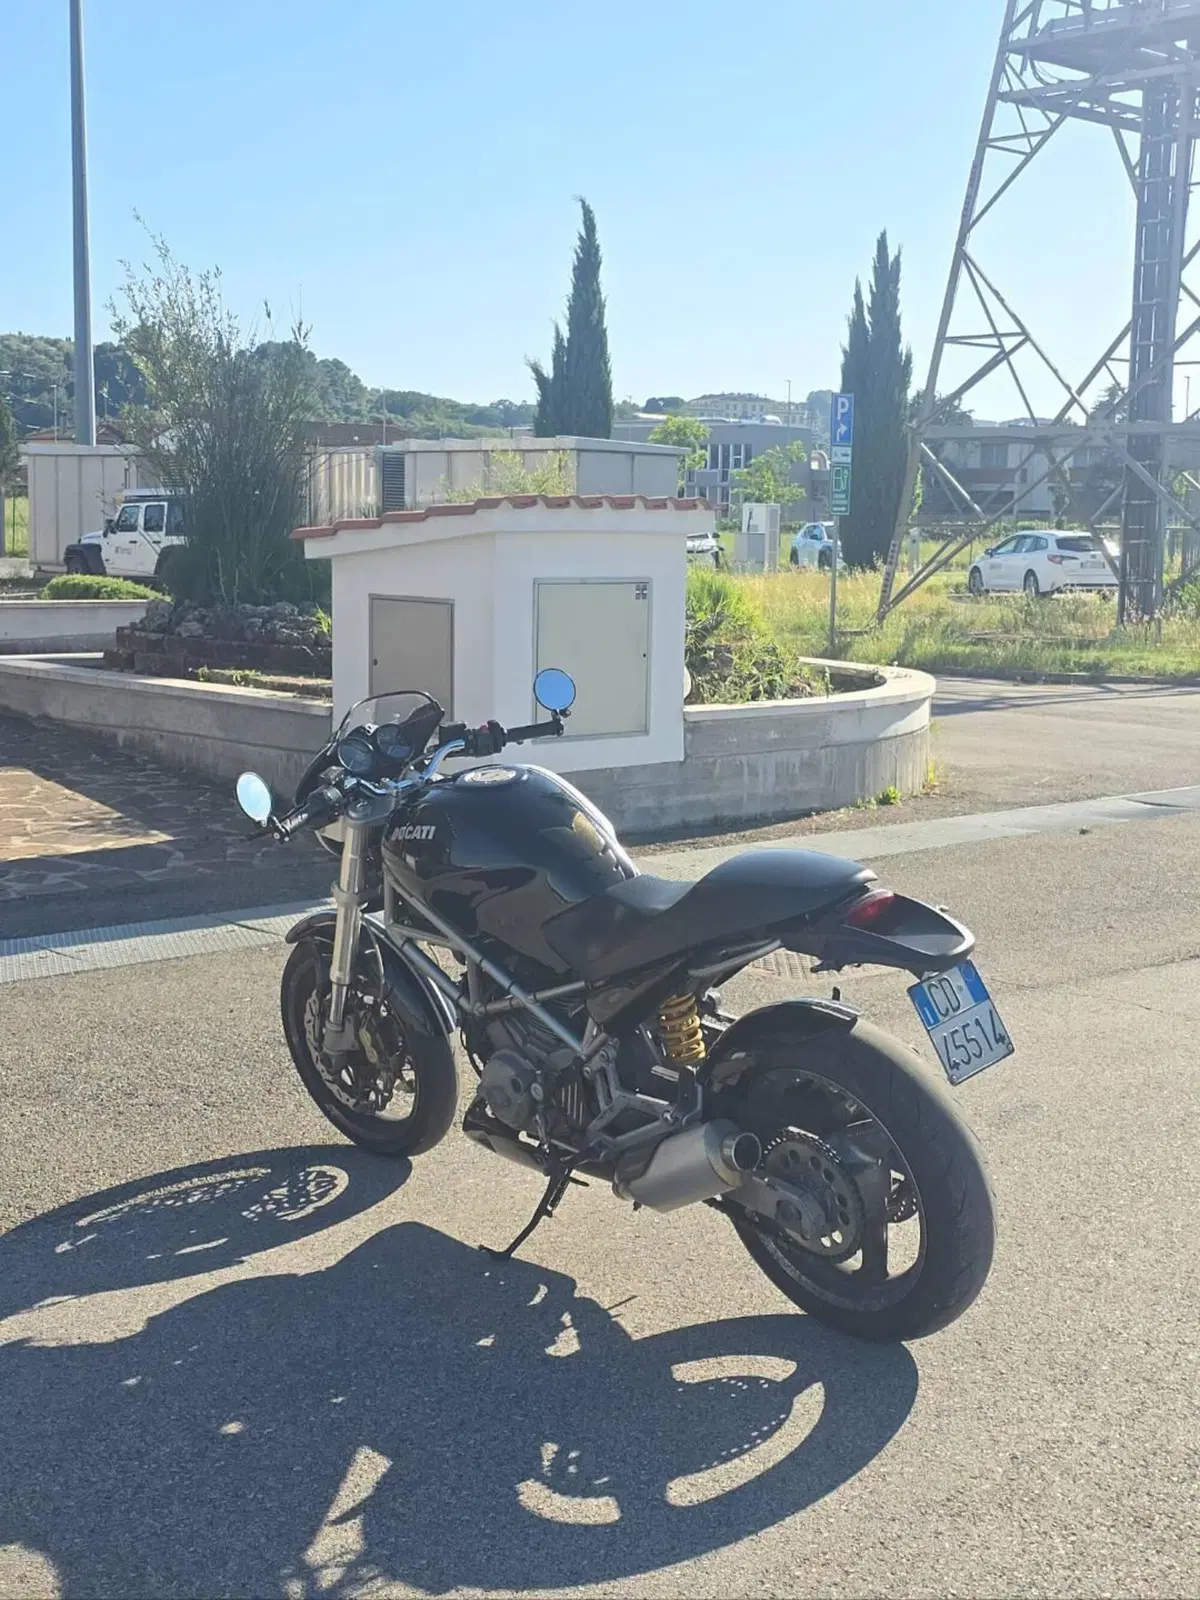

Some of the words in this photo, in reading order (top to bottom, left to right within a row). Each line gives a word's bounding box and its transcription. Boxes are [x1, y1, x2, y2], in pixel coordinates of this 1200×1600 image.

[836, 397, 849, 420] P
[927, 977, 961, 1018] CD
[942, 1009, 1006, 1071] 45514
